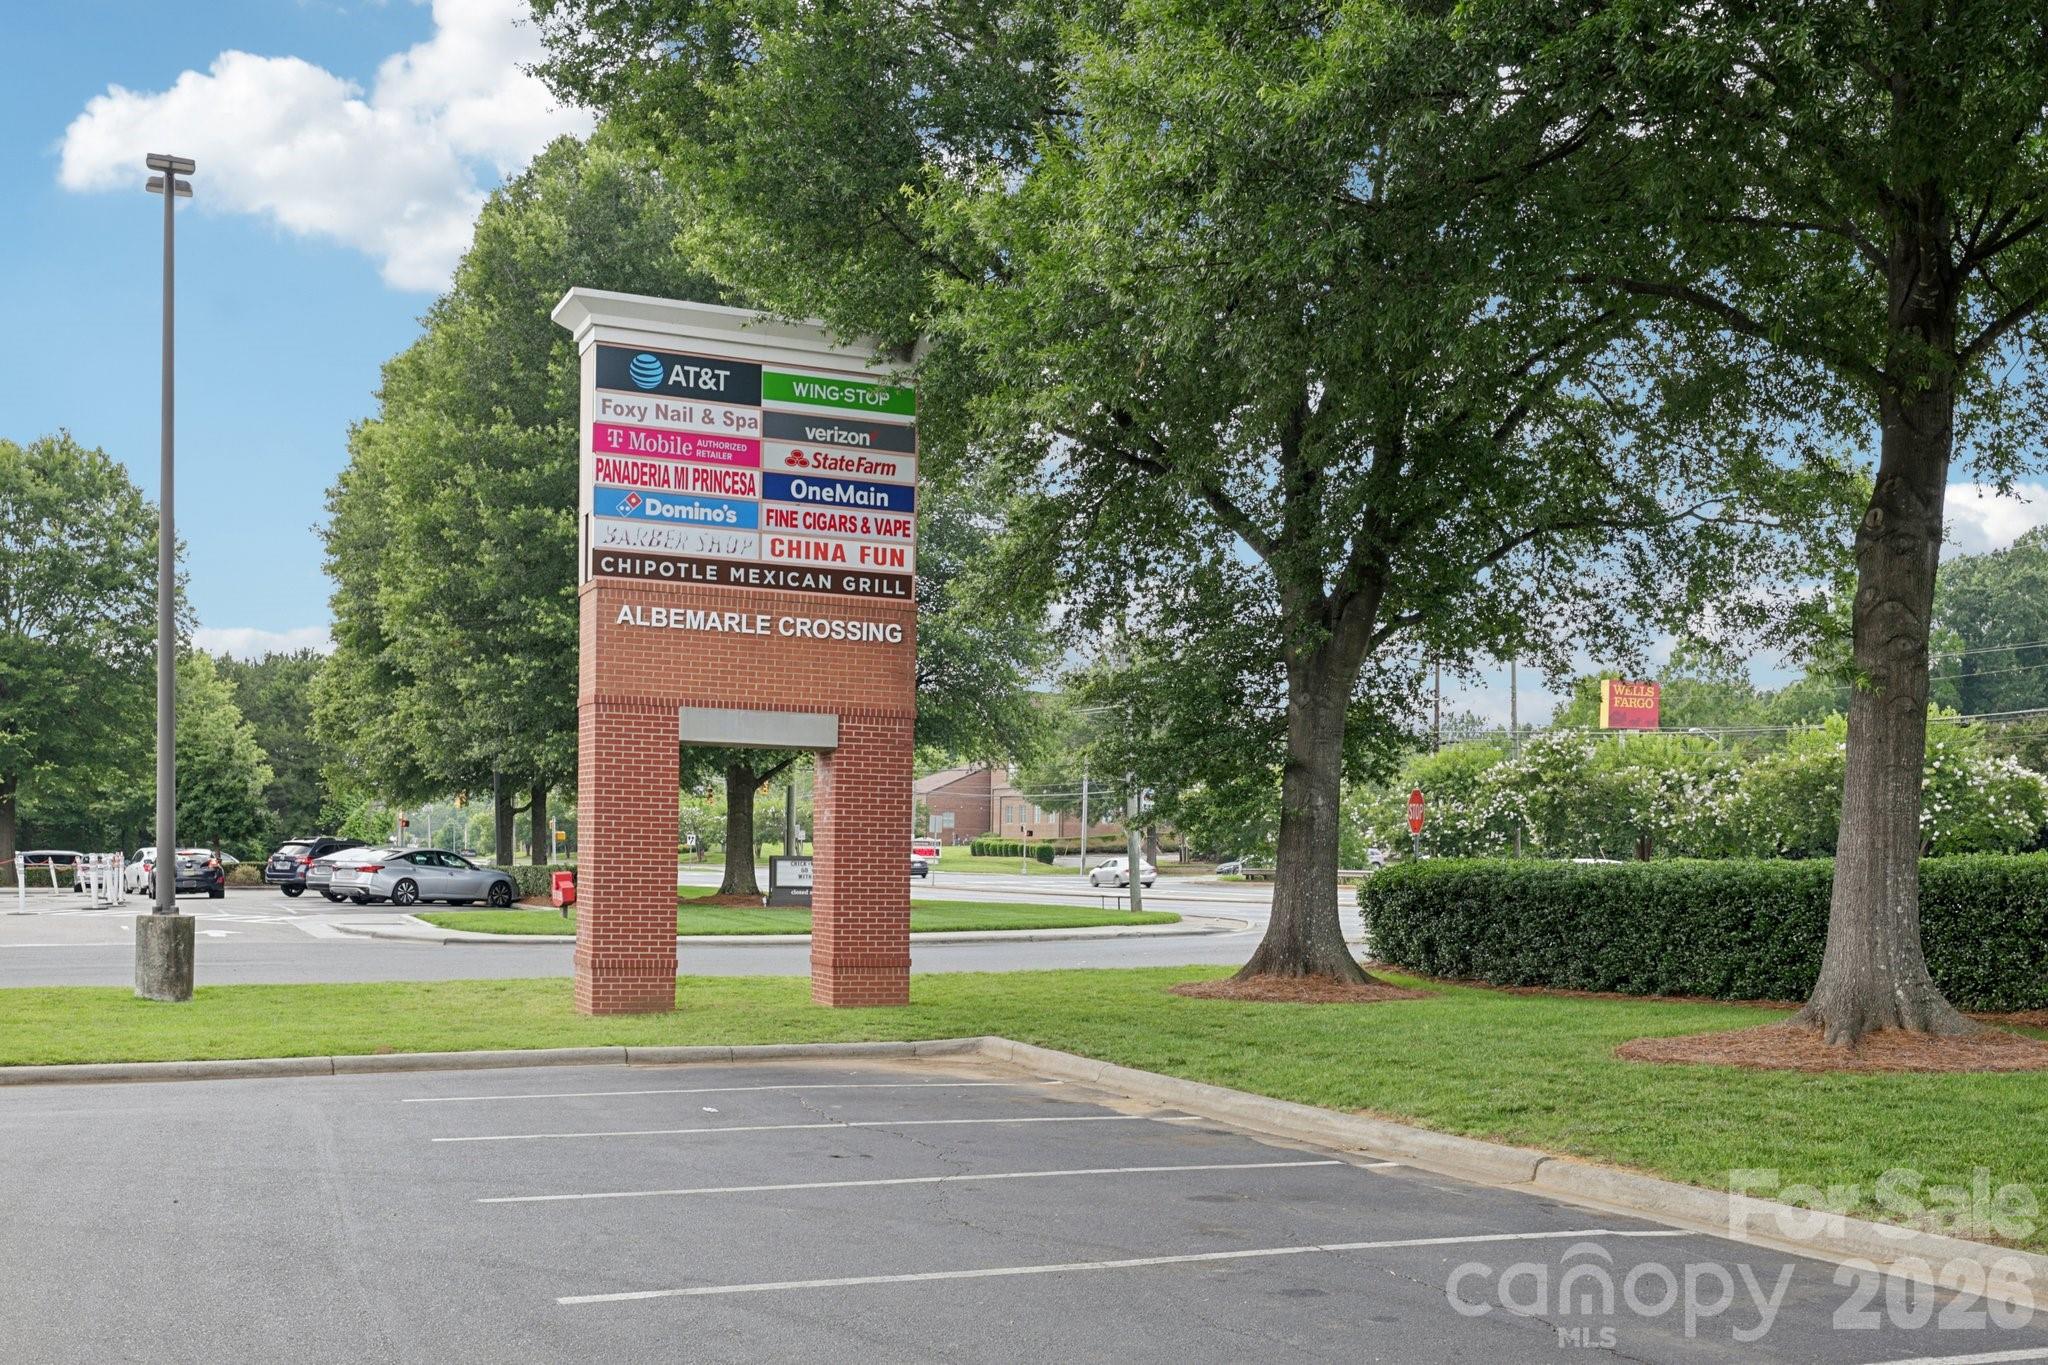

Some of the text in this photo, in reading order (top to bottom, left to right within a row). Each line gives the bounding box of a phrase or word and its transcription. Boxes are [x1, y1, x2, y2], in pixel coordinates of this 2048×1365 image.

[668, 364, 731, 392] AT&T
[601, 398, 759, 432] Foxy Nail & Spa
[628, 431, 693, 456] Mobile
[697, 439, 748, 452] AUTHORIZED
[805, 426, 871, 446] verizon
[696, 449, 733, 461] RETAILER
[595, 457, 757, 497] PANADERIA MI PRINCESA
[790, 479, 889, 507] OneMain
[645, 497, 738, 524] Domino's
[766, 508, 911, 538] FINE CIGARS & VAPE
[603, 525, 753, 556] BARBER SHOP
[770, 537, 905, 568] CHINA FUN
[601, 556, 906, 595] CHIPOTLE MEXICAN GRILL
[616, 604, 903, 644] ALBEMARLE CROSSING
[1613, 684, 1655, 697] WELLS
[1614, 696, 1654, 709] FARGO
[1409, 803, 1423, 820] STOP
